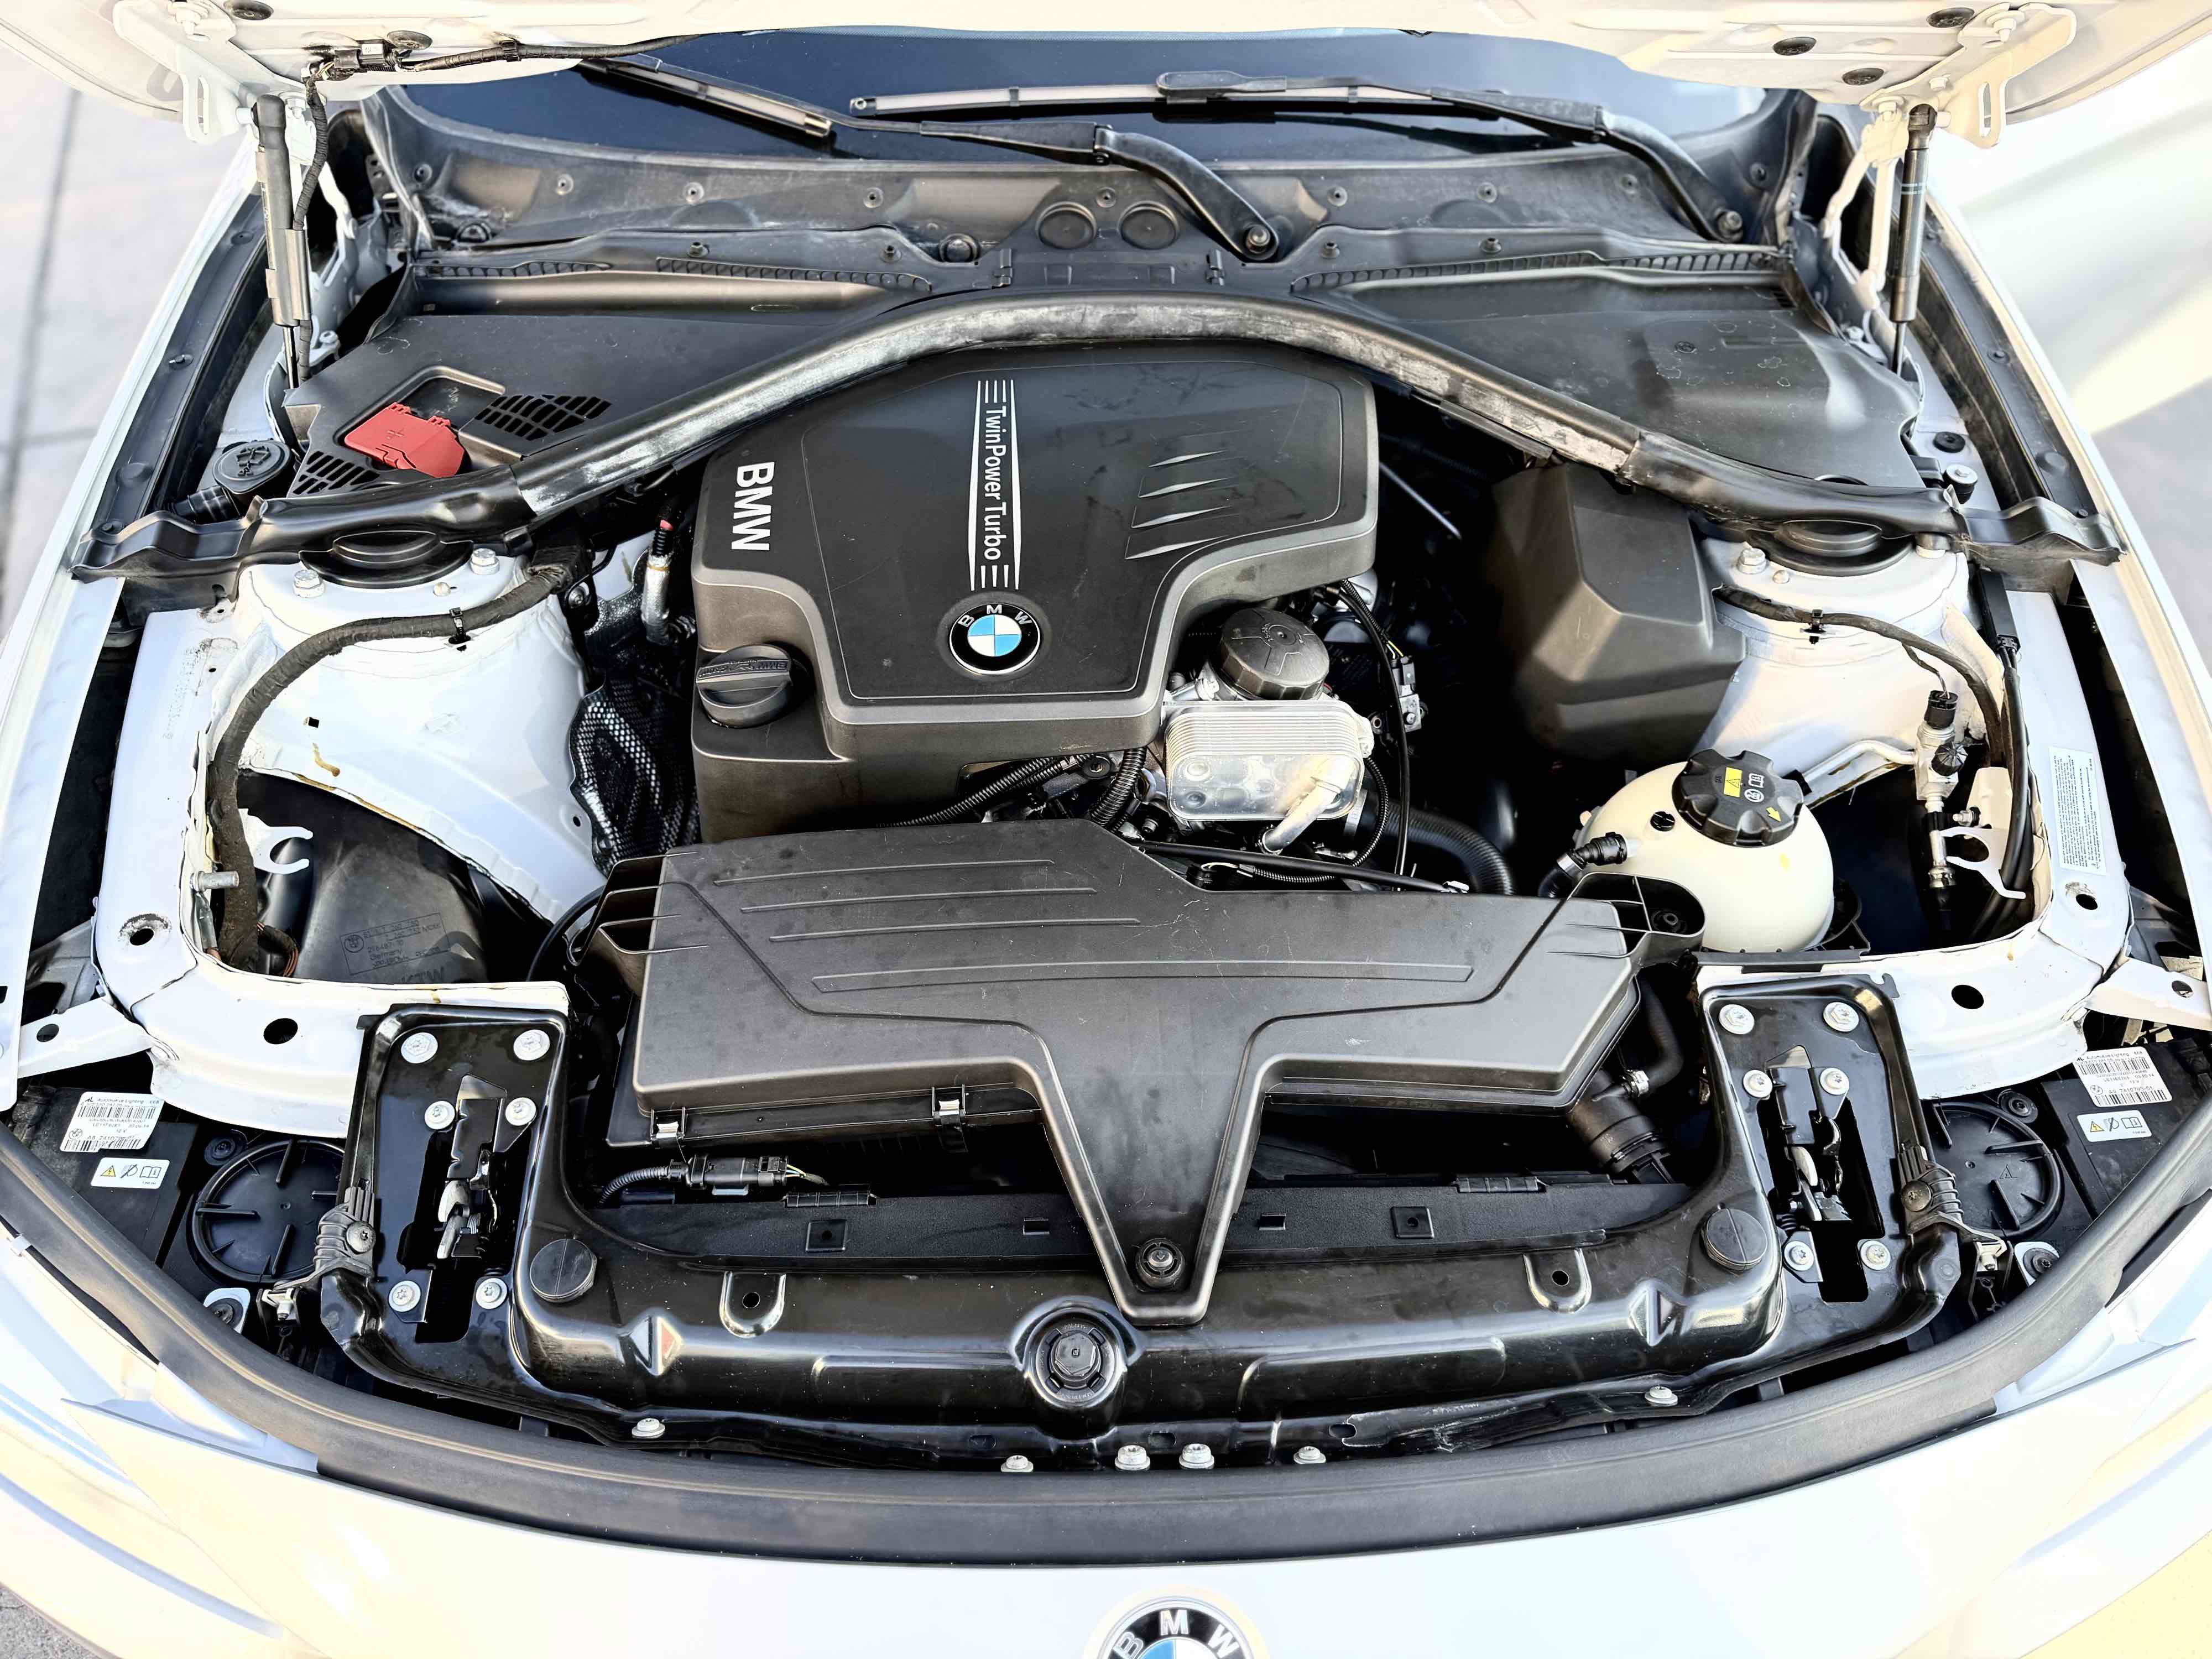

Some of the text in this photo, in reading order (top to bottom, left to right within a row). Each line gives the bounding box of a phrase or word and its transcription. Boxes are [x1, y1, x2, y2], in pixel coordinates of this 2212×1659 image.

[731, 461, 775, 551] BMW
[984, 406, 1007, 561] TwinPower Turbo
[957, 604, 1033, 628] BMW
[1113, 1610, 1239, 1659] BMW
